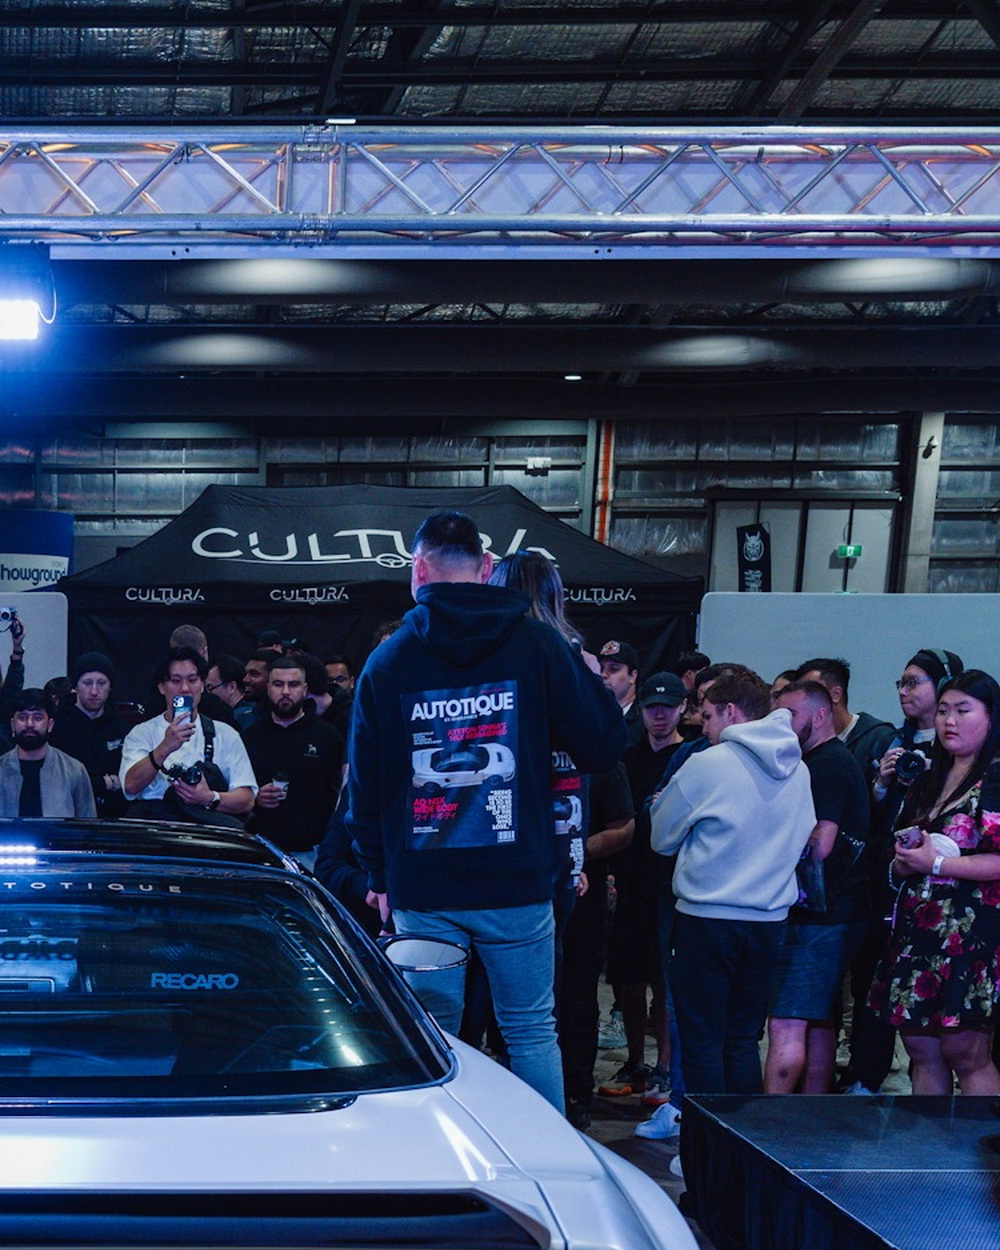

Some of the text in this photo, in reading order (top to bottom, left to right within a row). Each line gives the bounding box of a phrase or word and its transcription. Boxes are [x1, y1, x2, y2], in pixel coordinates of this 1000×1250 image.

[125, 587, 205, 602] CULTURA
[269, 586, 349, 602] CULTURA
[411, 692, 514, 721] AUTOTIQUE
[413, 803, 459, 813] WIDE BODY
[150, 972, 239, 990] RECARO
